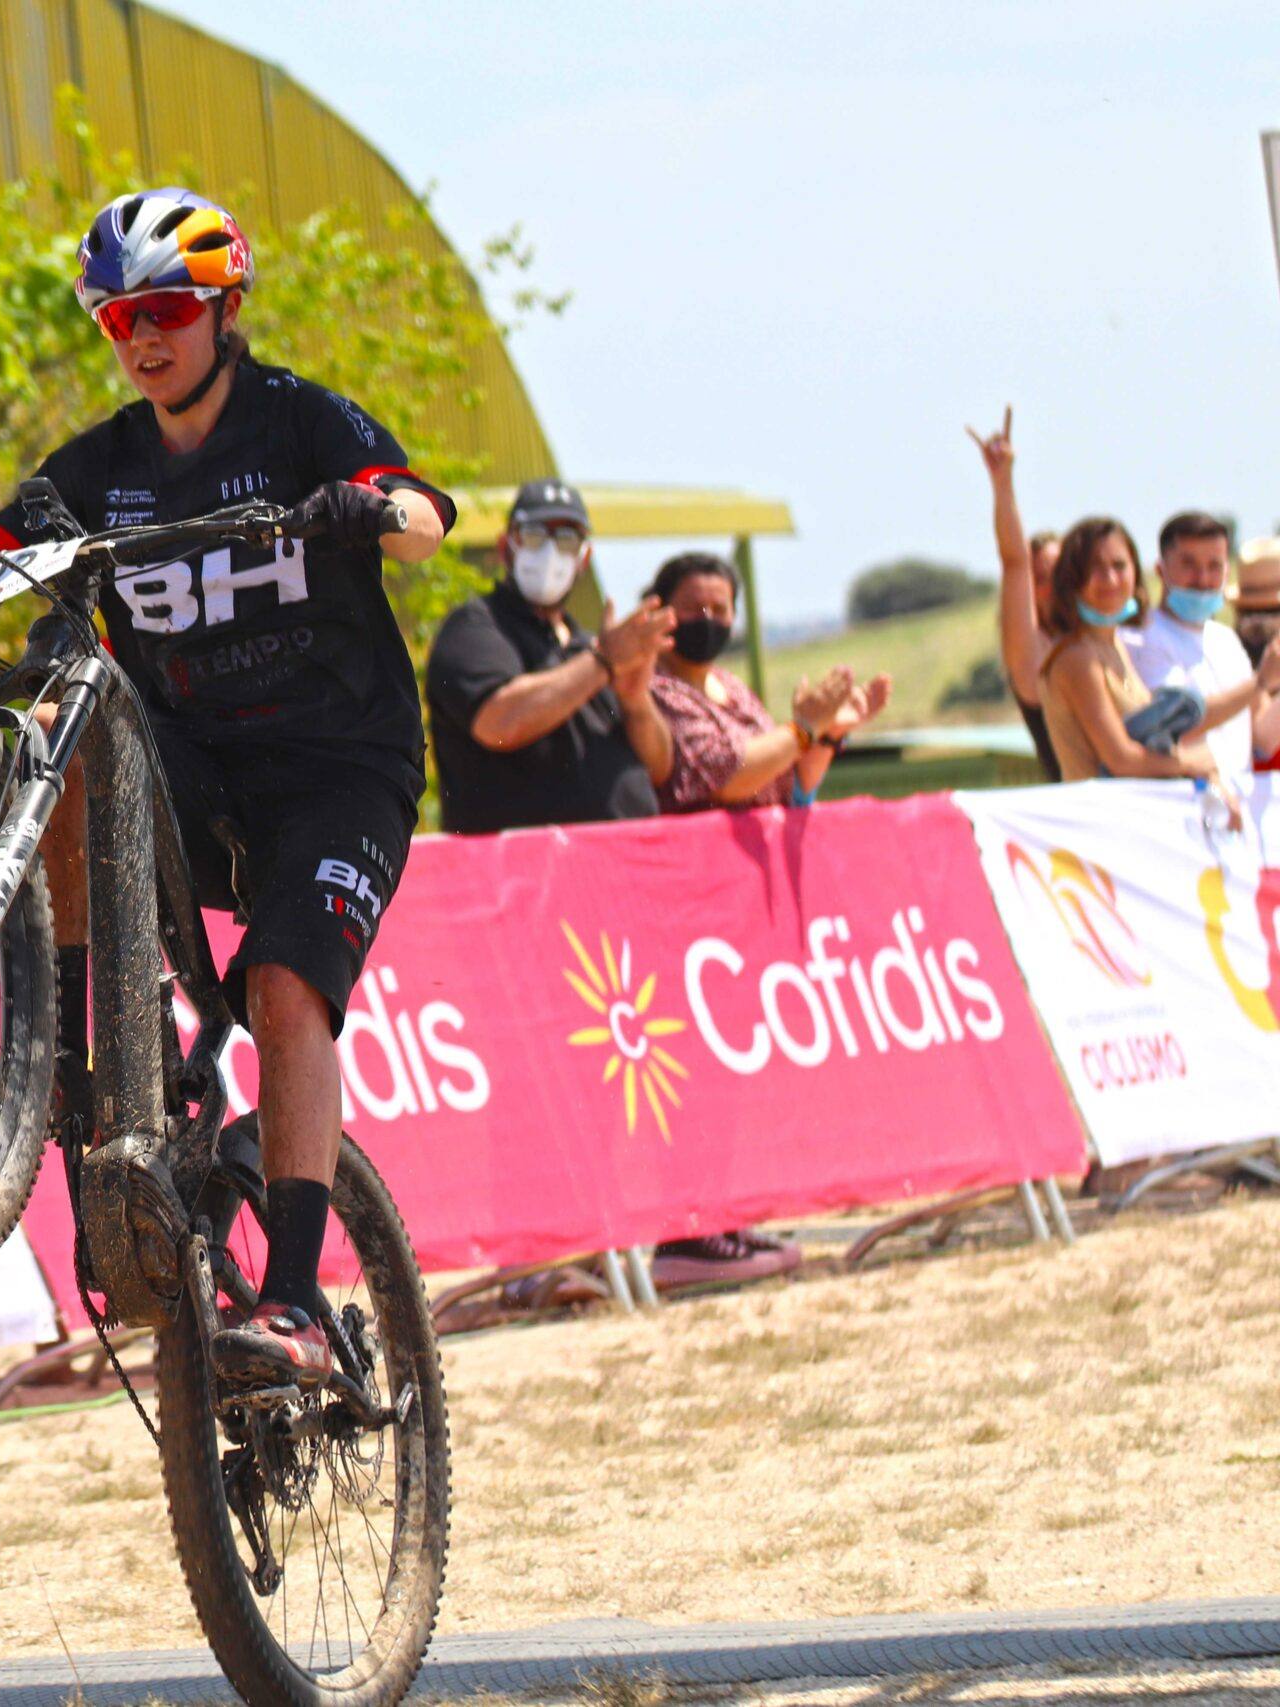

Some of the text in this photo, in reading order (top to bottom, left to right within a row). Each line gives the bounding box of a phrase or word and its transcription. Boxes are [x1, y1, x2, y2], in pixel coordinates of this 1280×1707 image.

[114, 537, 309, 634] BH
[314, 858, 381, 919] BH
[683, 906, 1005, 1075] Cofidis
